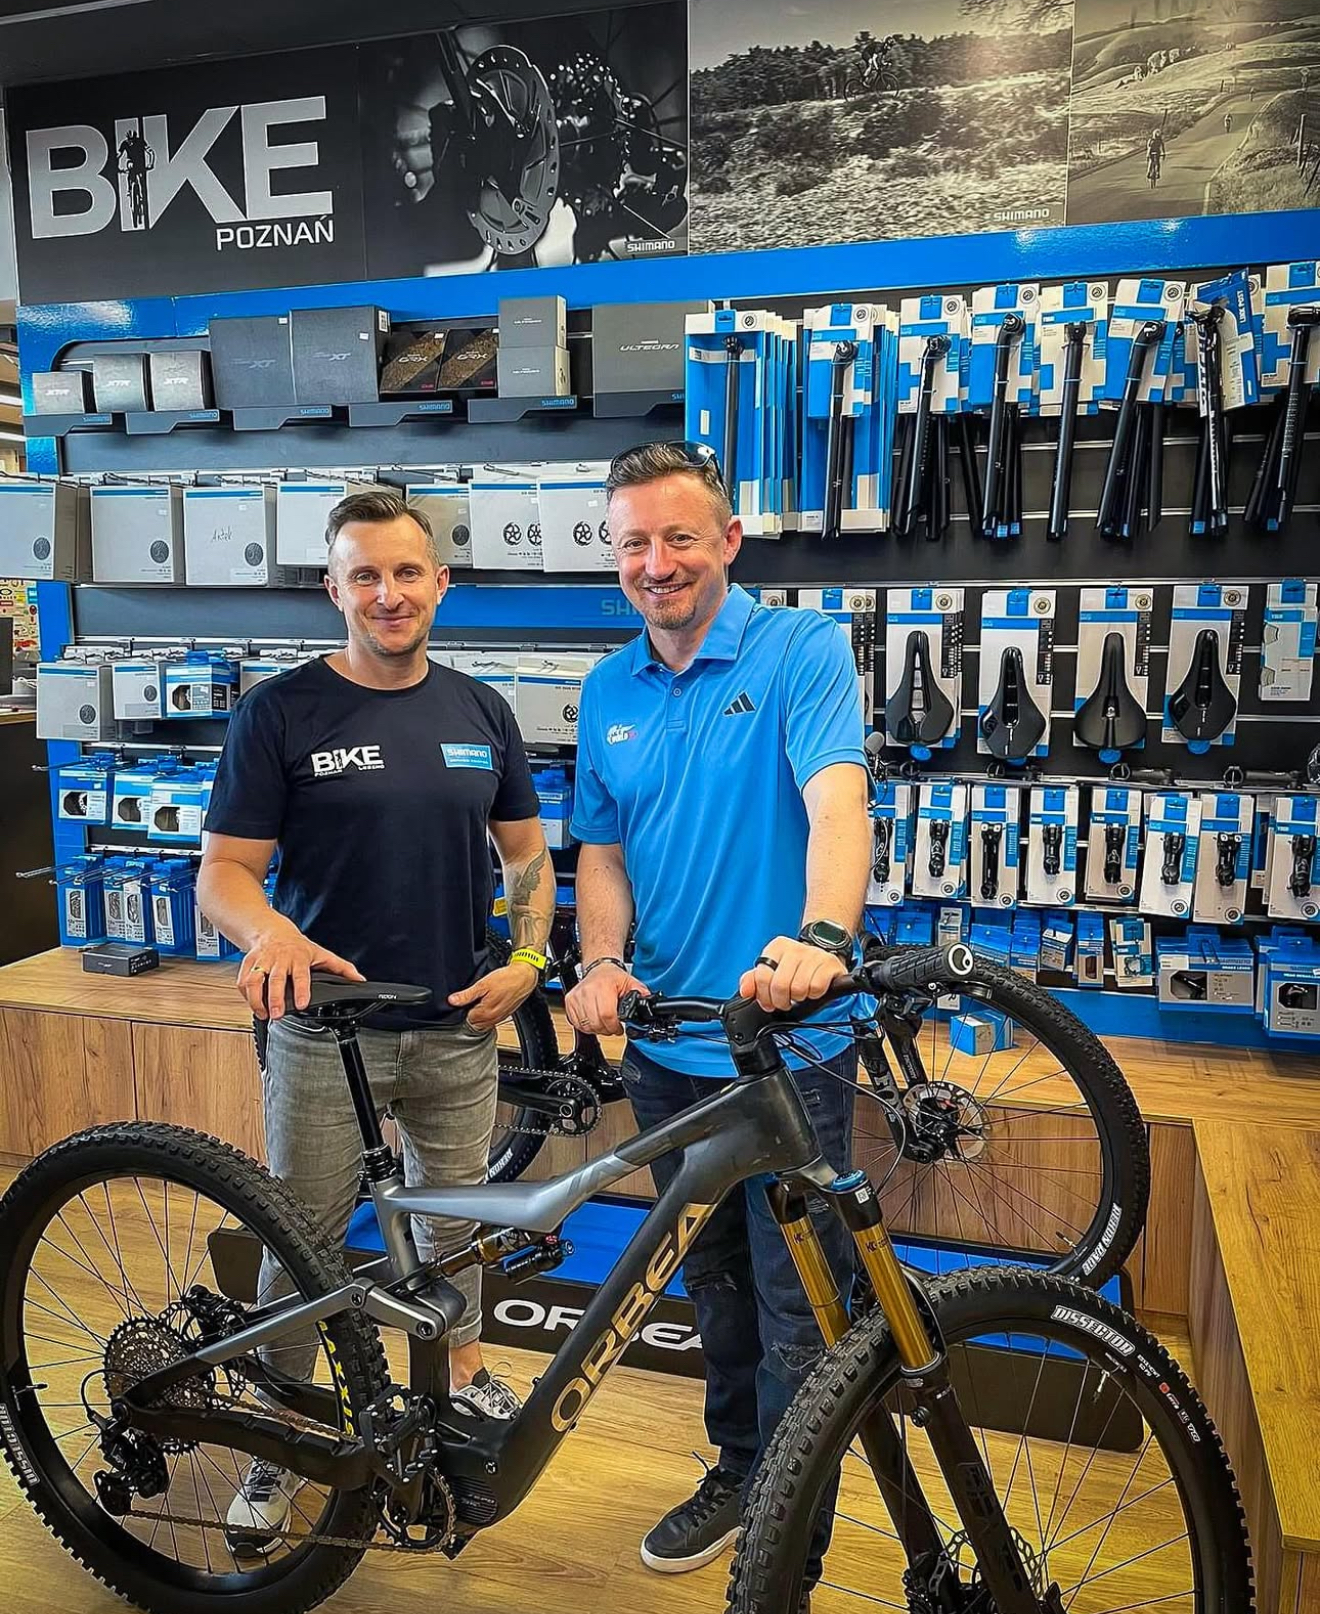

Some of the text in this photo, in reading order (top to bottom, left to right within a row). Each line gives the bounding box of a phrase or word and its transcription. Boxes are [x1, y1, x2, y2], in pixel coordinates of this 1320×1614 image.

[26, 95, 333, 239] BIKE
[993, 208, 1050, 221] SHIMANO
[216, 215, 334, 251] POZNAŃ
[627, 240, 675, 252] SHIMANO
[619, 343, 680, 351] ULTEGRA
[399, 355, 428, 363] GRX
[457, 352, 486, 361] GRX
[541, 399, 575, 407] SHIMANO
[311, 745, 384, 773] BIKE
[447, 748, 487, 758] SHIMANO
[551, 1203, 717, 1433] ORBEA
[493, 1299, 703, 1351] OREA
[1051, 1305, 1136, 1356] DISSECTOR
